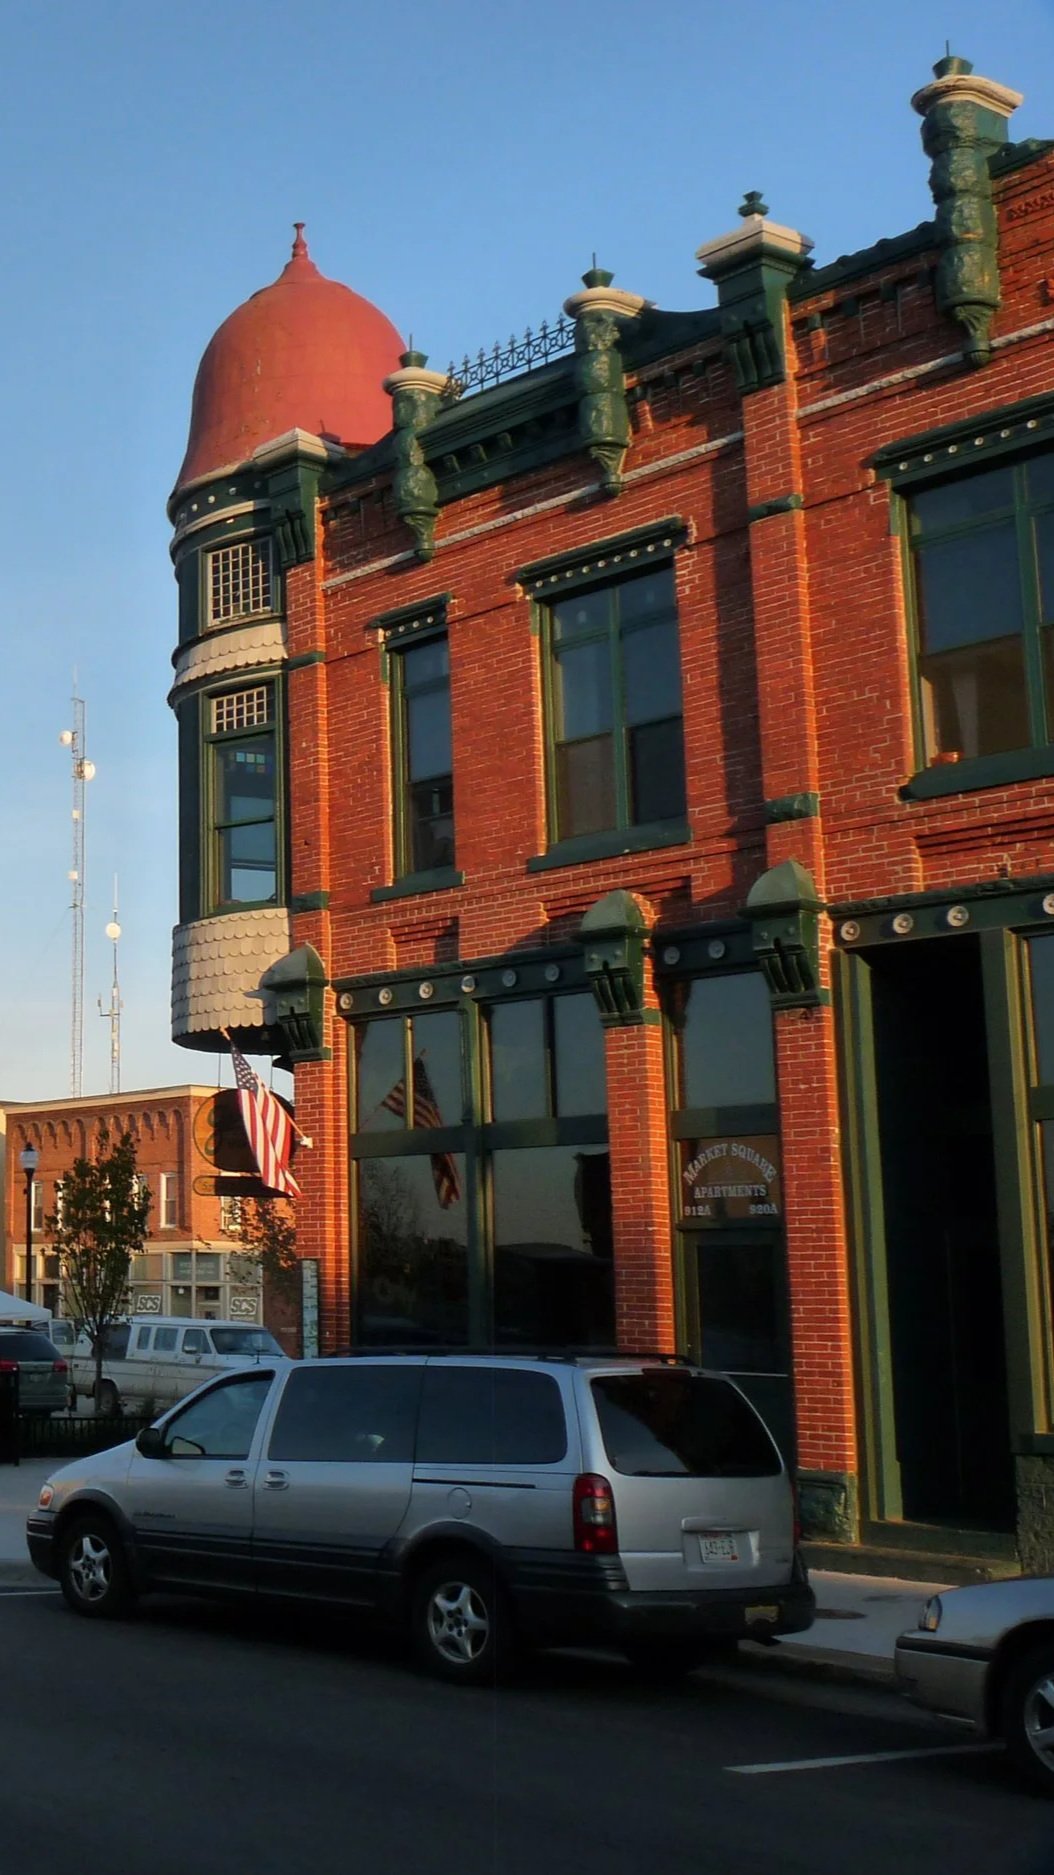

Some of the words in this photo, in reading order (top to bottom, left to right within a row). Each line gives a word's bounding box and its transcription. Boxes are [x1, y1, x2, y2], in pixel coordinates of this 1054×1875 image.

[683, 1143, 728, 1185] MARKET
[731, 1143, 777, 1183] SQUARE
[694, 1184, 767, 1198] APARTMENTS
[137, 1296, 160, 1311] SCS
[231, 1298, 257, 1314] SCS
